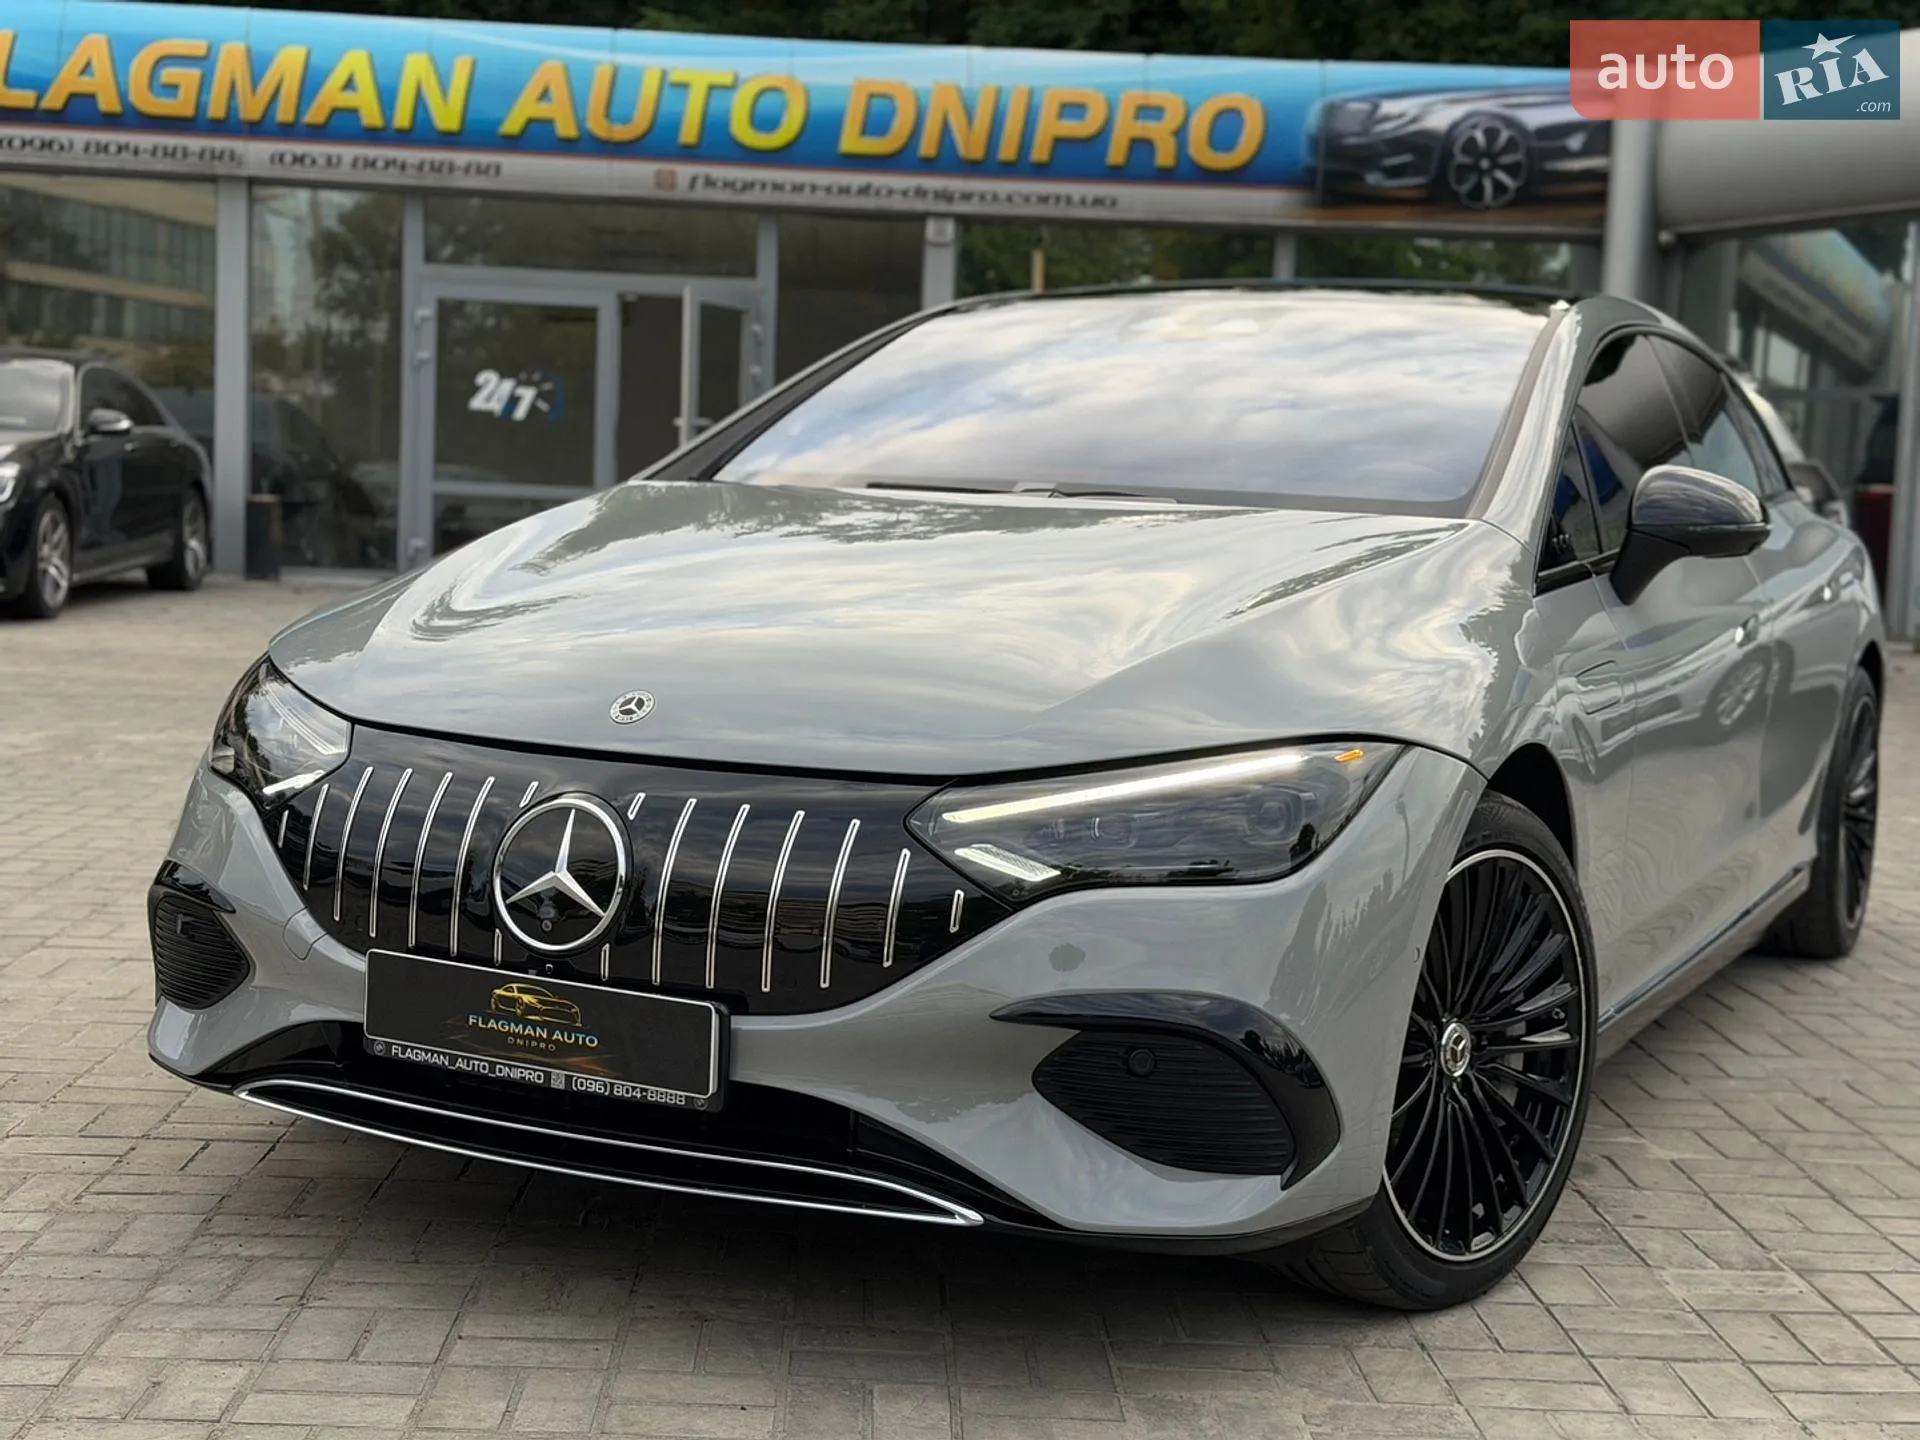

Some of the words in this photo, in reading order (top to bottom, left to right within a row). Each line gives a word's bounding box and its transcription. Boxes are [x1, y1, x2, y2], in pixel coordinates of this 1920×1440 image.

[498, 59, 812, 151] AUTO
[838, 78, 1267, 173] DNIPRO
[468, 1014, 548, 1039] FLAGMAN
[552, 1029, 599, 1048] AUTO
[507, 1036, 556, 1052] DNIPRO
[572, 1076, 610, 1096] (096)
[613, 1083, 686, 1105] 804-8888
